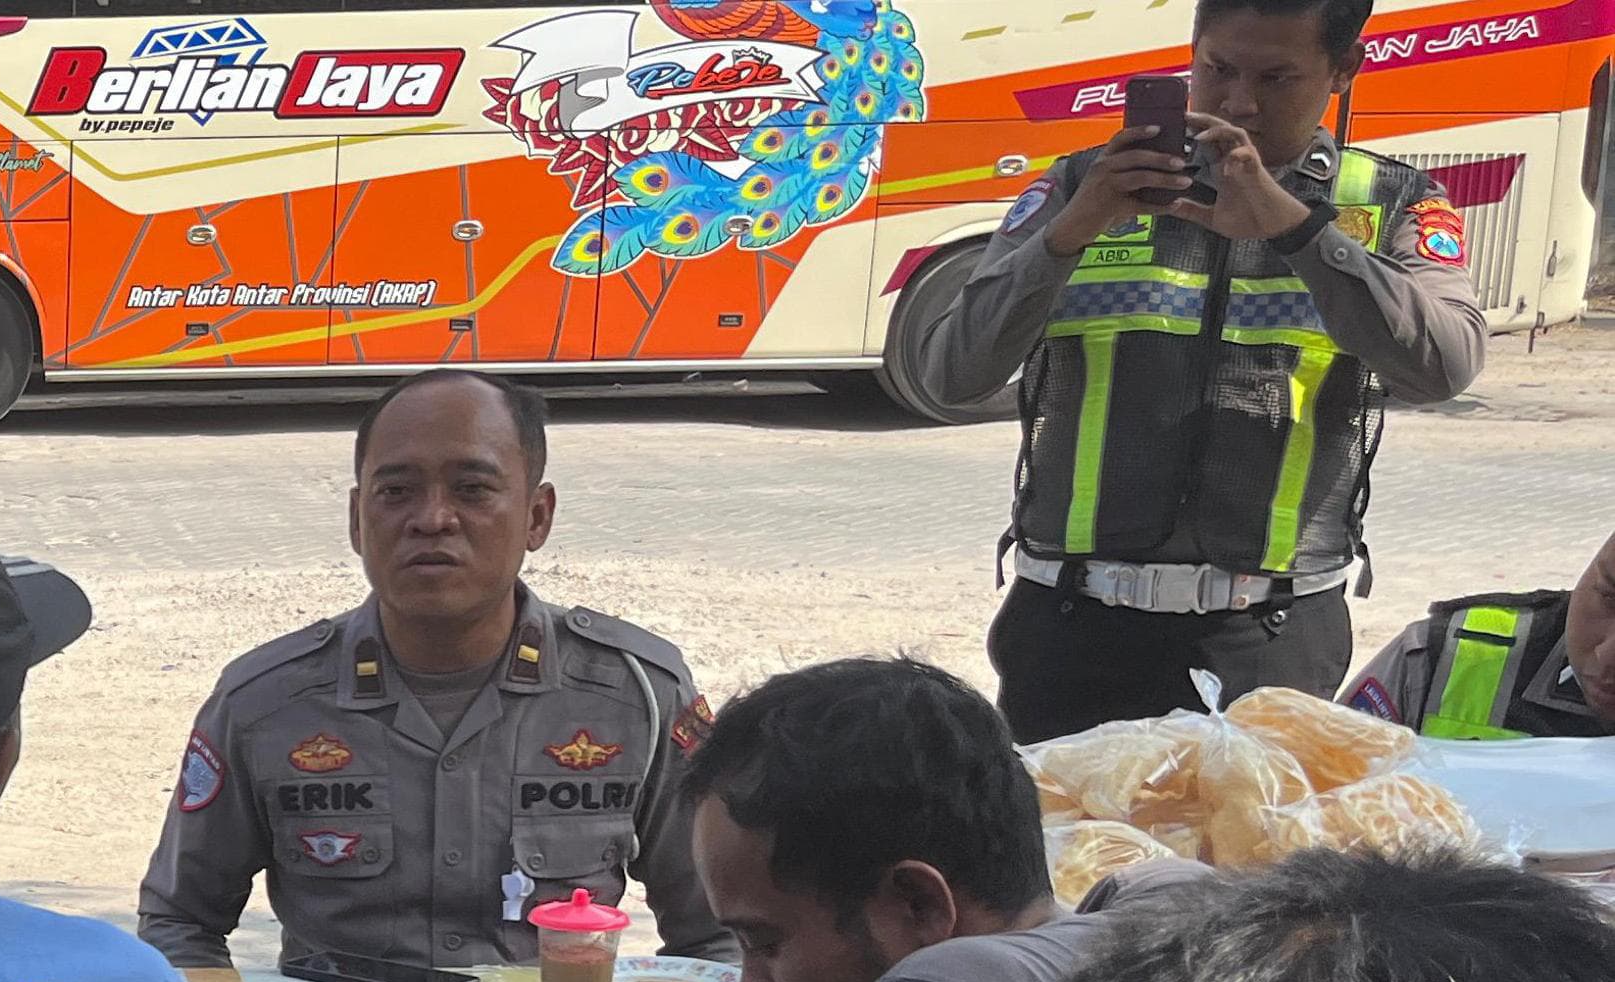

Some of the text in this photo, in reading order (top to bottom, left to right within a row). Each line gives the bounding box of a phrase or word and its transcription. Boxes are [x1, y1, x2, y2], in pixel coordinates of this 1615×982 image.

[1425, 15, 1539, 53] JAYA
[25, 46, 445, 116] Berlian Jaya
[1094, 249, 1130, 263] ABID
[127, 280, 438, 308] Antar Kota Antar Provinsi (AKAP)
[278, 782, 374, 812] ERIK
[520, 781, 640, 810] POLRI
